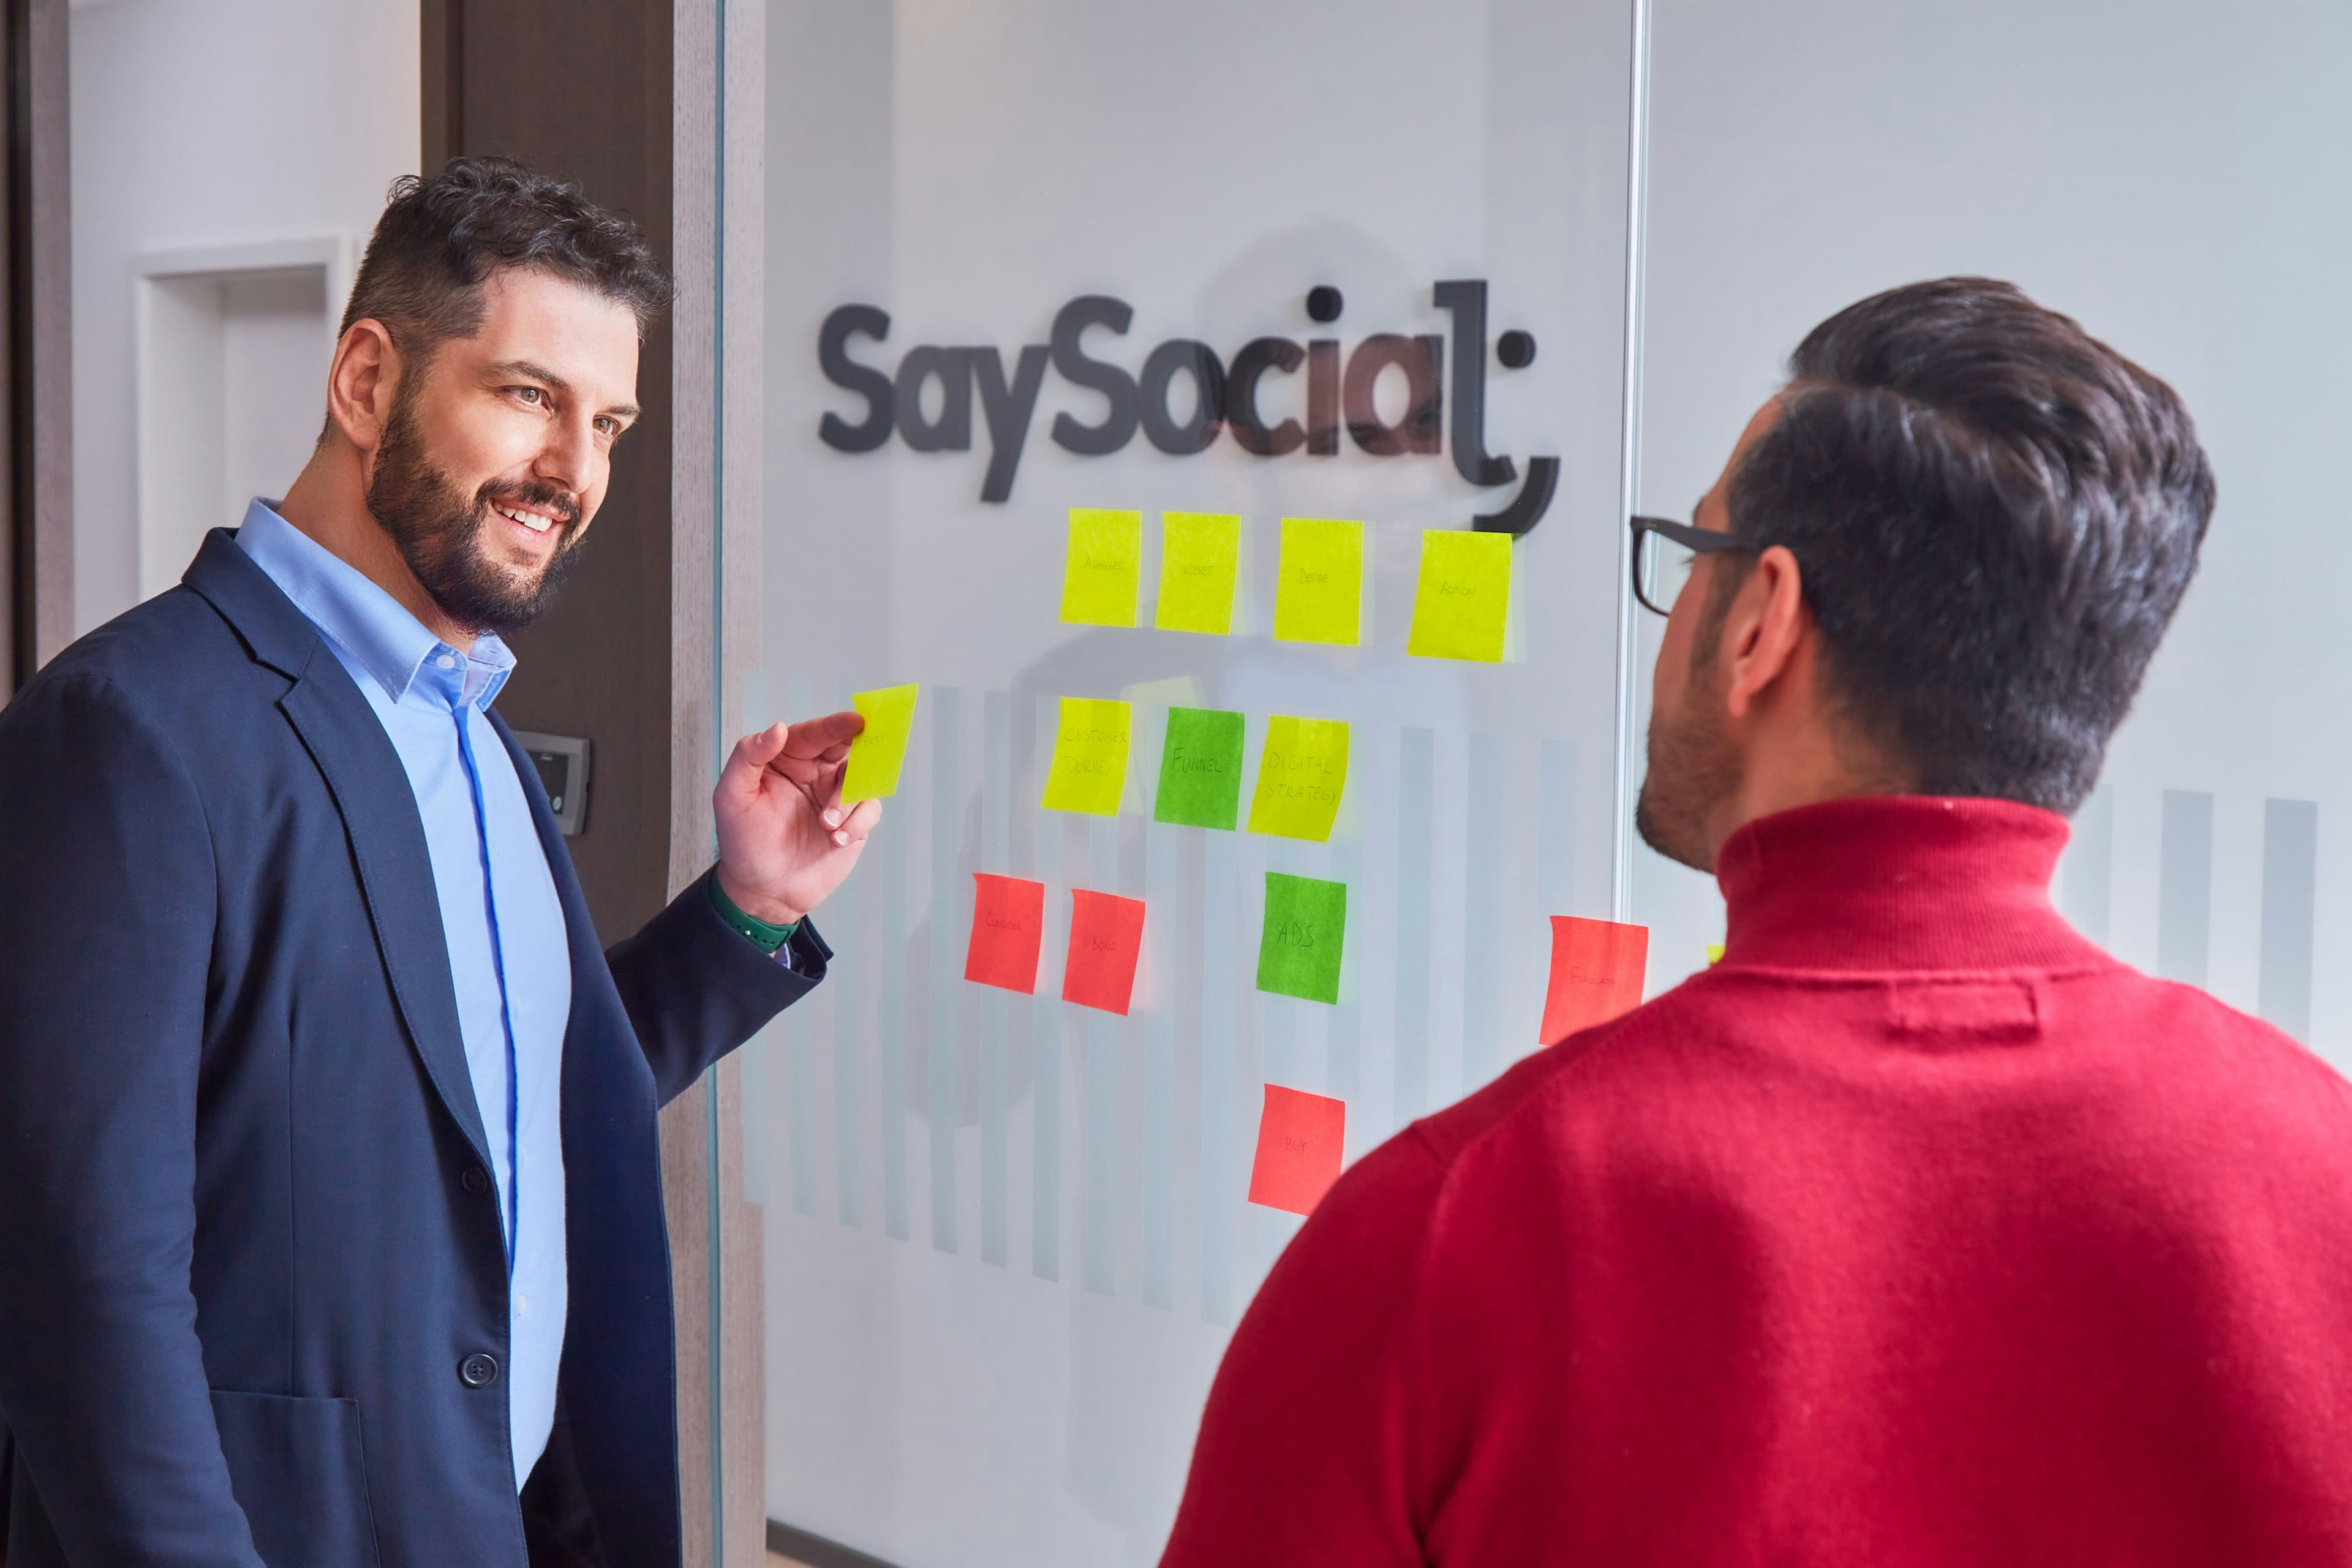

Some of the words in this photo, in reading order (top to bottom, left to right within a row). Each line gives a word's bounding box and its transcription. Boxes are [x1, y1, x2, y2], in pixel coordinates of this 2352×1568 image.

[1181, 562, 1215, 576] INTEREST
[1298, 568, 1330, 584] DESIRE
[1440, 581, 1476, 597] ACTION
[1065, 728, 1128, 743] CUSTOMER
[1061, 756, 1113, 775] JOURNEY
[1172, 747, 1222, 774] FUNNEL
[1268, 751, 1332, 775] DIGITAL
[1266, 783, 1341, 805] STRATEGY
[1277, 920, 1315, 948] ADS
[1285, 1137, 1307, 1153] BUY
